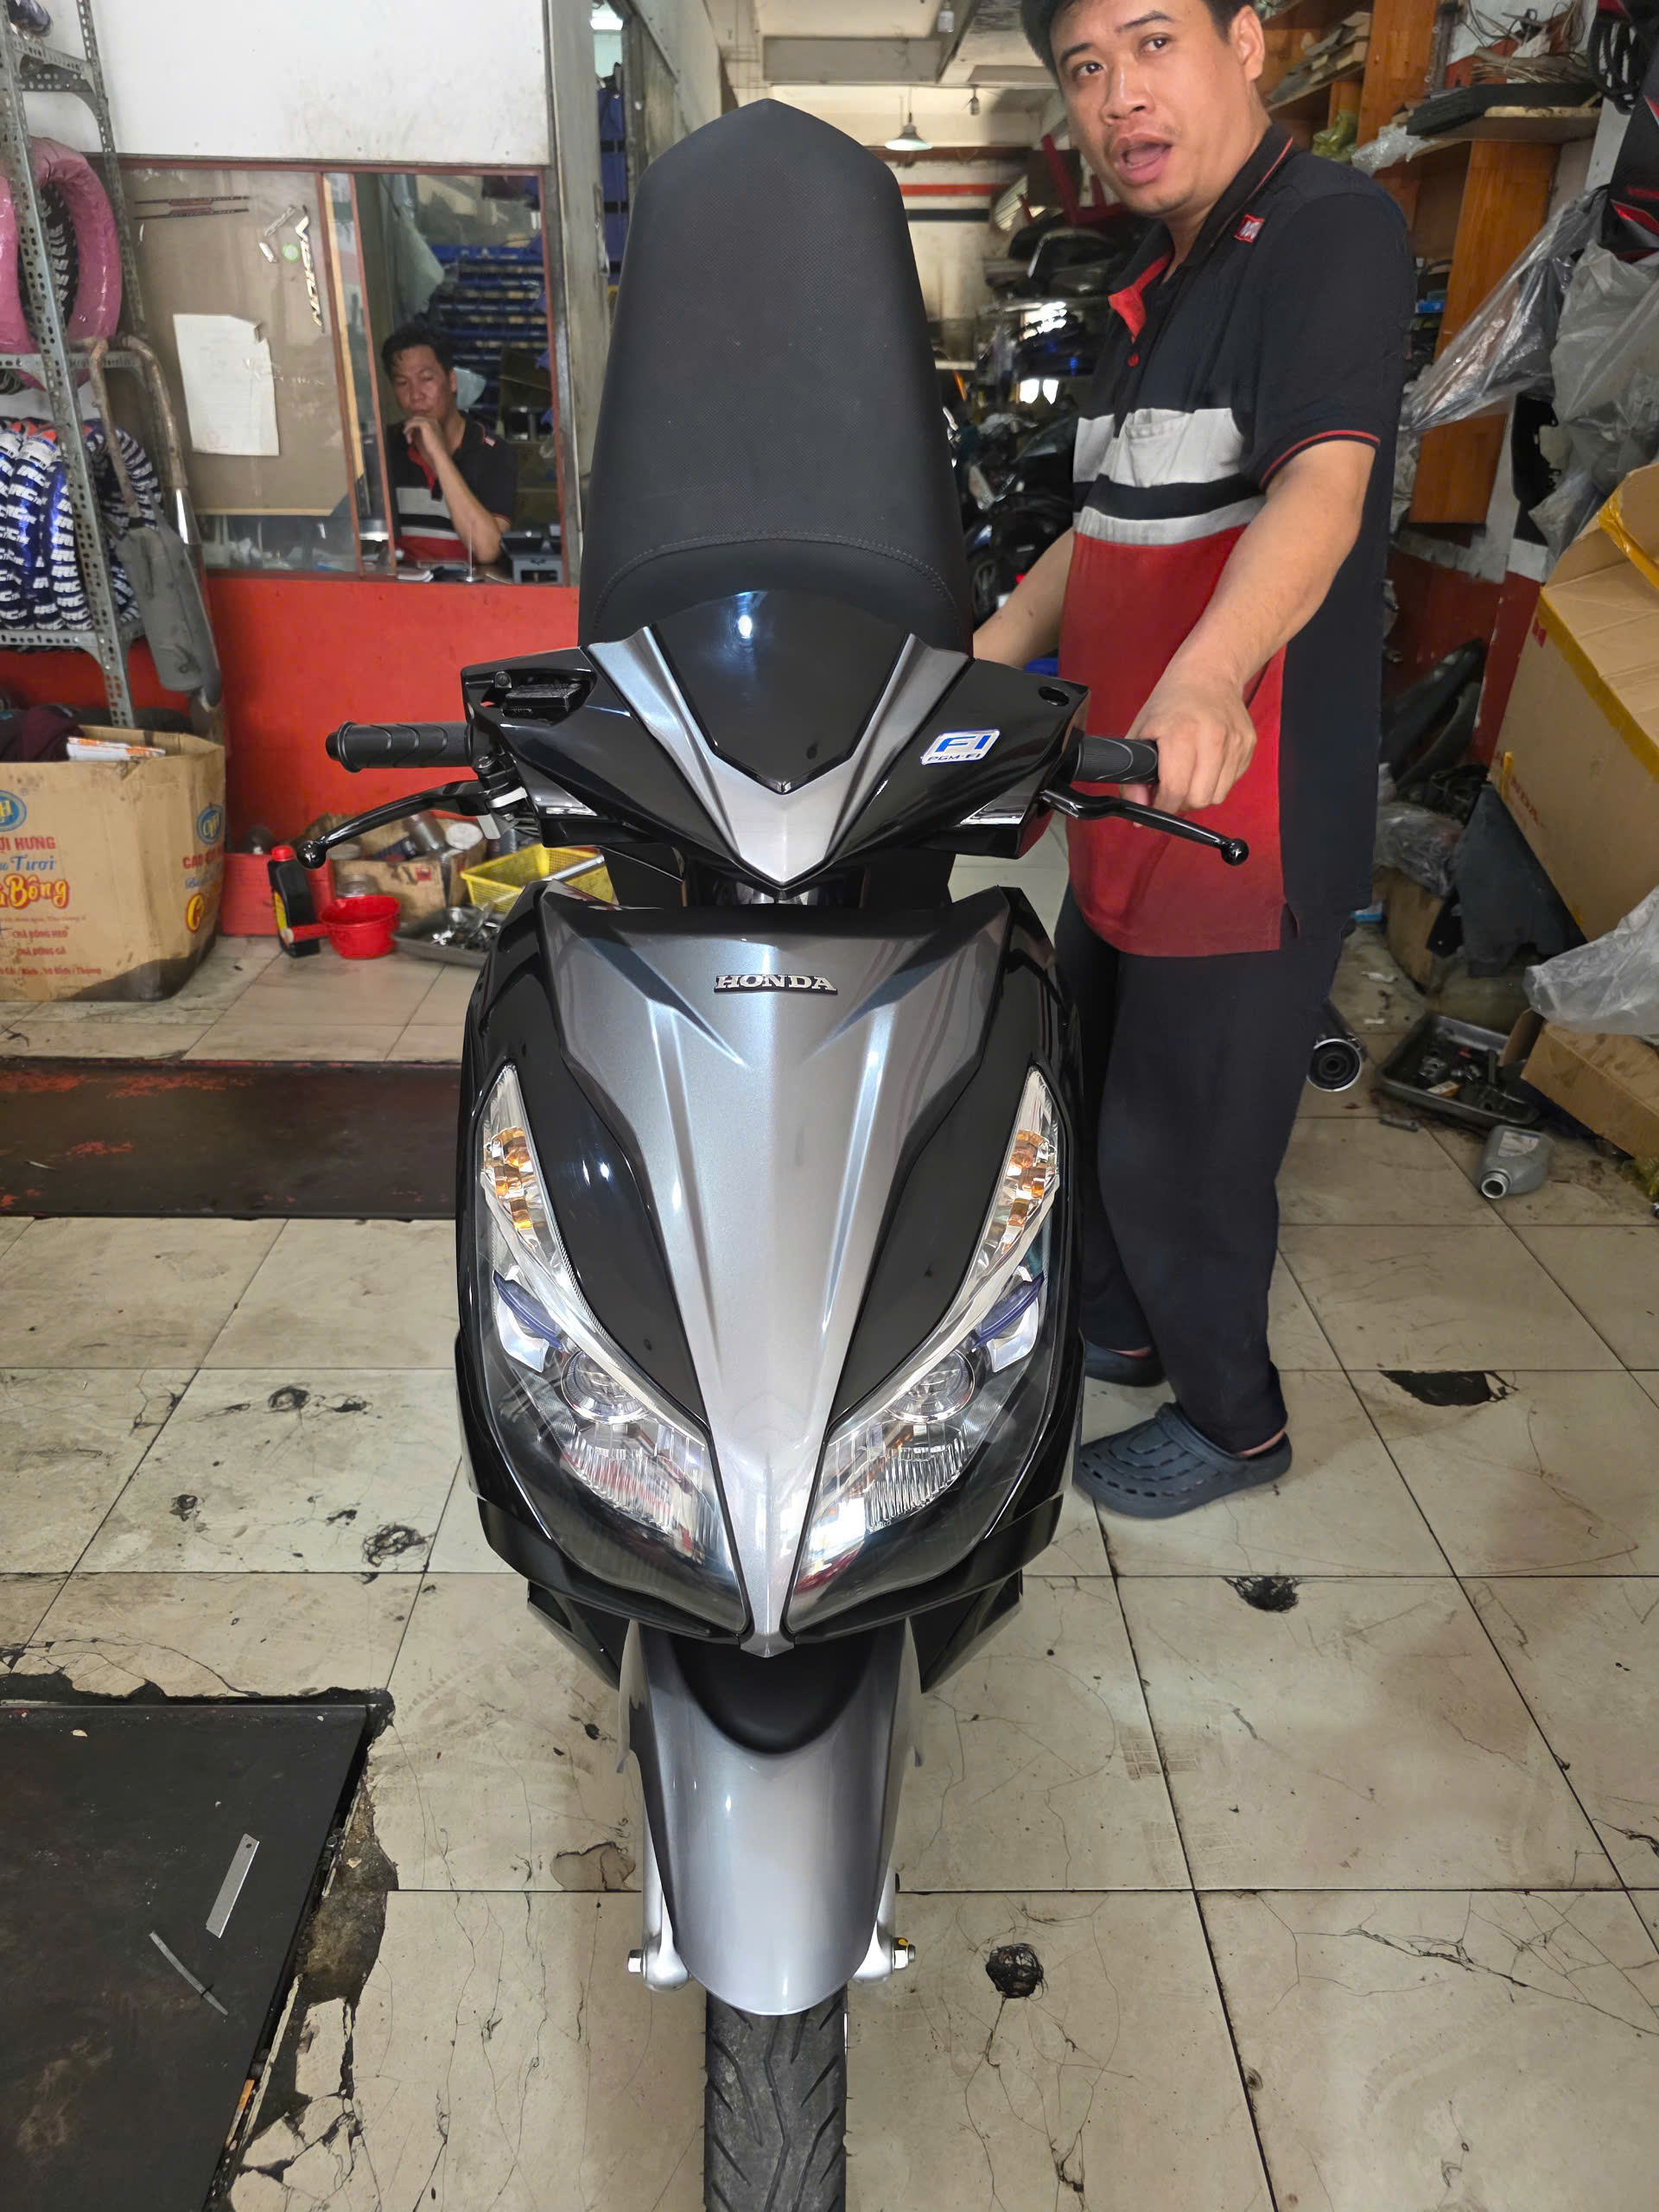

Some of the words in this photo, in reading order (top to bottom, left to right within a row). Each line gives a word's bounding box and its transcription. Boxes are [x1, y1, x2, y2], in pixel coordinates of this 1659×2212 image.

[935, 734, 993, 753] FI
[927, 753, 982, 761] PGM-FI
[3, 873, 71, 910] Bông
[715, 974, 837, 991] HONDA
